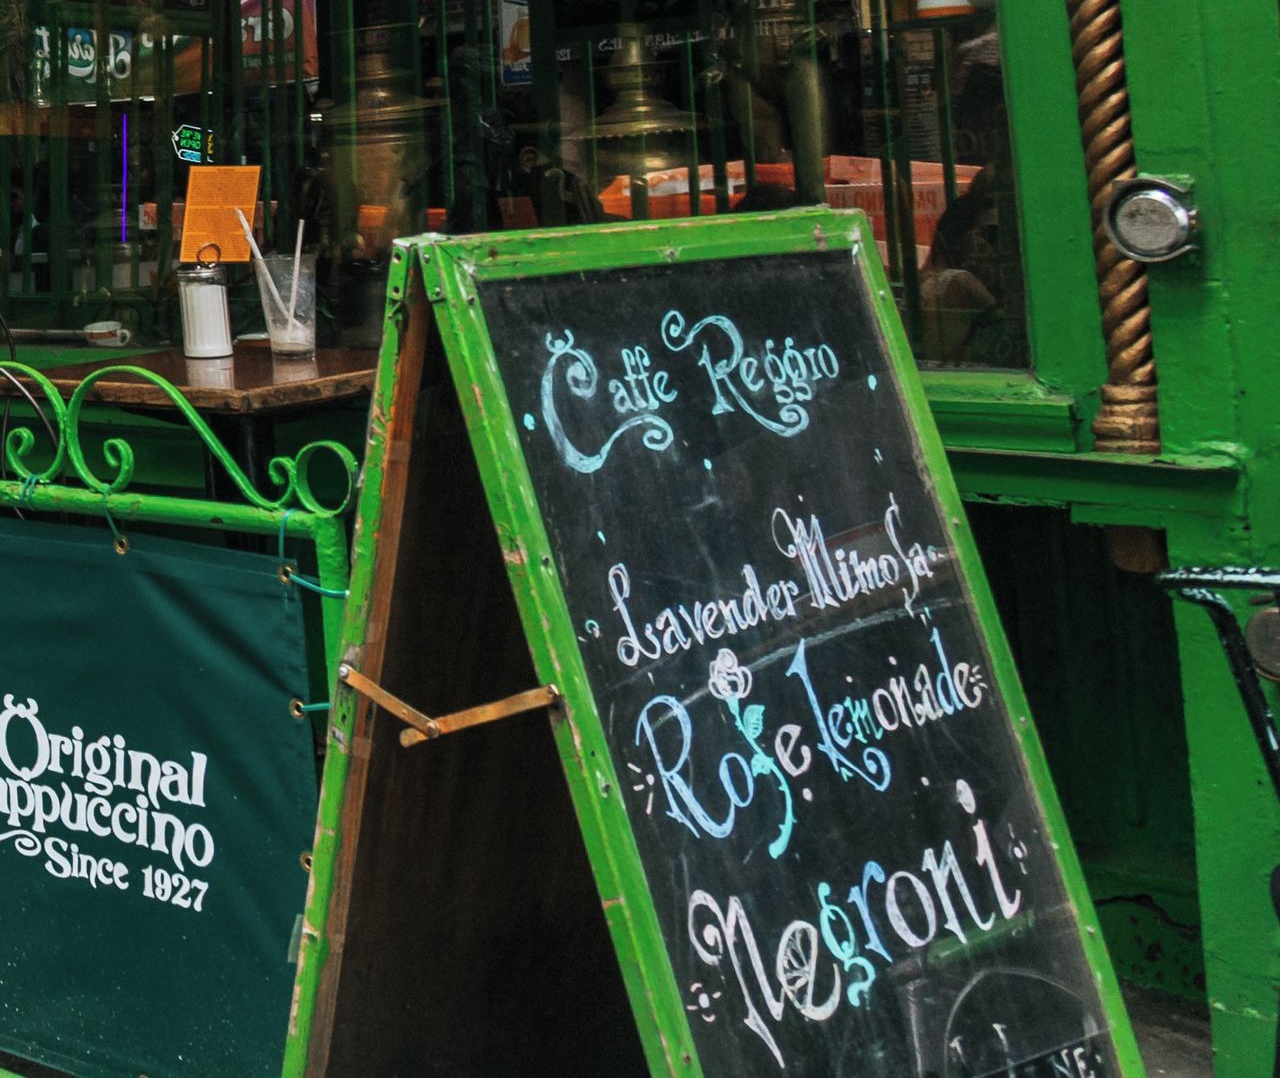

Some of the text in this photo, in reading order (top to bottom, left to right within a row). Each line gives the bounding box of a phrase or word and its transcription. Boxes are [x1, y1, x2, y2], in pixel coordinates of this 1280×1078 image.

[541, 309, 840, 474] Caffe Reggio
[607, 561, 799, 667] Lavender
[44, 836, 209, 912] Since 1927
[688, 778, 1021, 1069] Negroni
